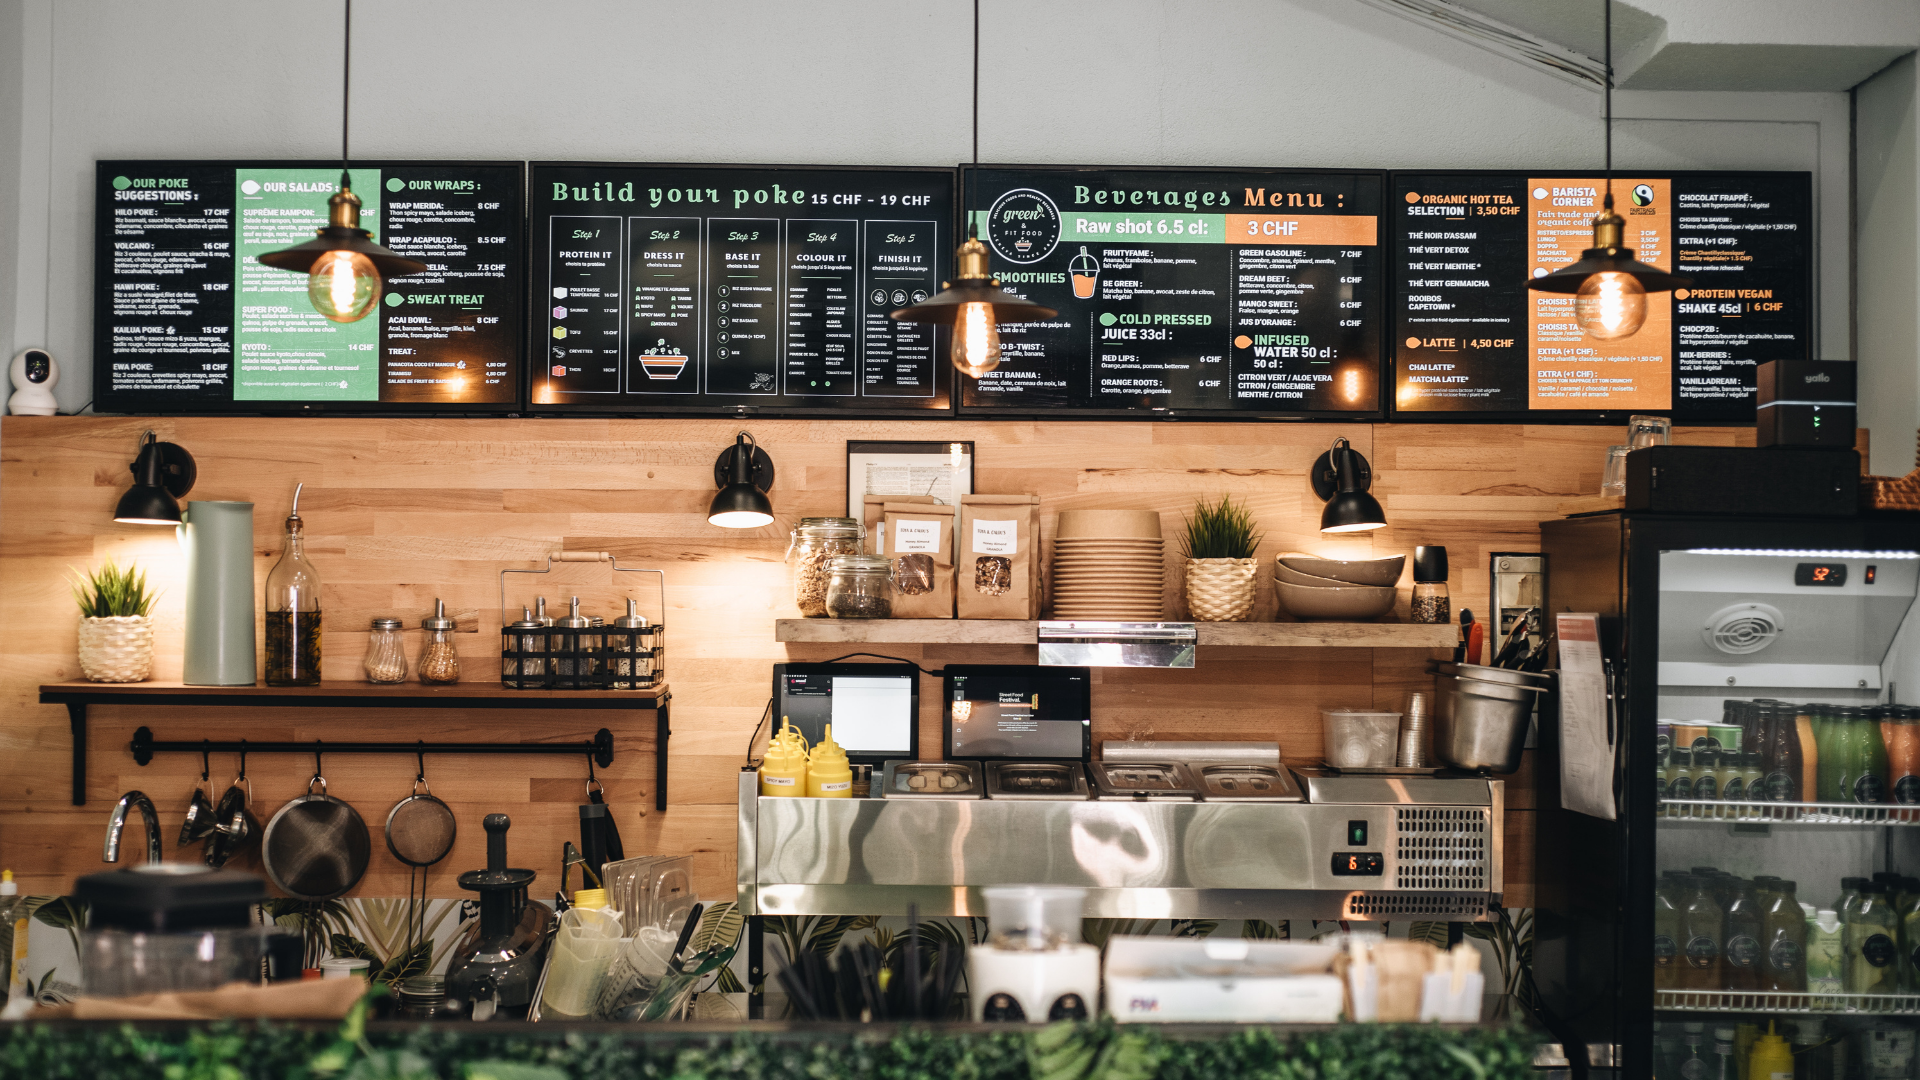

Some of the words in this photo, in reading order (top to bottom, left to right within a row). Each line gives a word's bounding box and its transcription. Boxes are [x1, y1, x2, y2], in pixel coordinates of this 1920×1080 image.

[133, 178, 156, 188] OUR
[158, 178, 188, 188] POKE
[263, 182, 287, 192] OUR
[289, 182, 333, 192] SALADS
[409, 180, 432, 190] OUR
[434, 180, 474, 190] WRAPS
[115, 190, 192, 201] SUGGESTIONS
[552, 182, 635, 202] Build
[648, 188, 720, 208] your
[733, 184, 805, 209] poke
[1552, 187, 1597, 197] BARISTA
[811, 194, 829, 204] 15
[833, 194, 862, 205] CHF
[881, 195, 897, 205] 19
[902, 195, 930, 206] CHF
[1074, 185, 1230, 211] Beverages
[1244, 188, 1324, 207] Menu
[1422, 195, 1468, 204] ORGANIC
[1470, 195, 1491, 204] HOT
[1492, 195, 1513, 204] TEA
[1552, 197, 1594, 206] CORNER
[1719, 193, 1749, 201] FRAPPÉ
[389, 202, 412, 210] WRAP
[412, 202, 444, 210] MERIDA:
[478, 202, 483, 210] 8
[484, 202, 500, 210] CHF
[115, 208, 133, 216] HILO
[133, 208, 154, 216] POKE
[243, 208, 278, 216] SUPRÊME
[1408, 206, 1464, 216] SELECTION
[1477, 206, 1498, 217] 3,50
[1499, 206, 1520, 215] CHF
[1537, 210, 1553, 218] Fair
[1555, 210, 1581, 218] trade
[1003, 209, 1038, 224] green
[1076, 218, 1111, 233] Raw
[1115, 218, 1153, 234] shot
[1157, 219, 1184, 235] 6.5
[1188, 219, 1208, 235] cl:
[1537, 219, 1569, 227] organic
[1247, 221, 1258, 235] 3
[1263, 221, 1298, 236] CHF
[572, 229, 593, 240] Step
[595, 229, 600, 238] 1
[649, 230, 670, 241] Step
[672, 230, 680, 239] 2
[885, 234, 906, 244] Step
[908, 234, 915, 243] 5
[1408, 231, 1424, 239] THÉ
[114, 242, 151, 250] VOLCANO
[203, 242, 213, 250] 16
[213, 242, 229, 250] CHF
[603, 251, 612, 259] IT
[644, 252, 673, 260] DRESS
[675, 252, 685, 260] IT
[725, 253, 749, 261] BASE
[751, 253, 761, 261] IT
[1103, 249, 1150, 257] FRUITYFAME
[1239, 249, 1264, 257] GREEN
[1265, 249, 1302, 257] GASOLINE
[1340, 250, 1346, 258] 7
[1347, 250, 1362, 258] CHF
[796, 254, 835, 262] COLOUR
[879, 255, 910, 263] FINISH
[913, 255, 922, 263] IT
[993, 272, 1065, 284] SMOOTHIES
[135, 283, 156, 291] POKE
[1691, 289, 1736, 298] PROTEIN
[1737, 289, 1772, 298] VEGAN
[407, 294, 447, 304] SWEAT
[448, 295, 484, 304] TREAT
[1678, 303, 1716, 313] SHAKE
[1718, 303, 1741, 314] 45cl
[1754, 302, 1761, 311] 6
[1762, 302, 1783, 311] CHF
[388, 316, 407, 324] ACAI
[408, 316, 432, 324] BOWL:
[1119, 314, 1151, 324] COLD
[1154, 314, 1212, 325] PRESSED
[113, 326, 141, 334] KAILUA
[142, 326, 164, 334] POKE:
[1679, 325, 1715, 333] CHOCP2B
[1101, 328, 1137, 340] JUICE
[1139, 328, 1166, 340] 33cl
[1254, 334, 1309, 346] INFUSED
[1423, 338, 1456, 347] LATTE
[242, 343, 267, 351] KYOTO
[1007, 343, 1041, 351] B-TWIST
[1253, 346, 1299, 358] WATER
[1301, 347, 1317, 358] 50
[1319, 347, 1330, 358] cl
[1537, 348, 1561, 356] EXTRA
[1562, 348, 1574, 356] (+1
[1576, 348, 1594, 356] CHF)
[1679, 351, 1727, 359] MIX-BERRIES
[1005, 371, 1037, 379] BANANA
[1238, 373, 1267, 381] CITRON
[1287, 374, 1292, 382] /
[1312, 374, 1333, 382] VERA
[1805, 372, 1830, 383] yallo
[1348, 855, 1357, 870] 6
